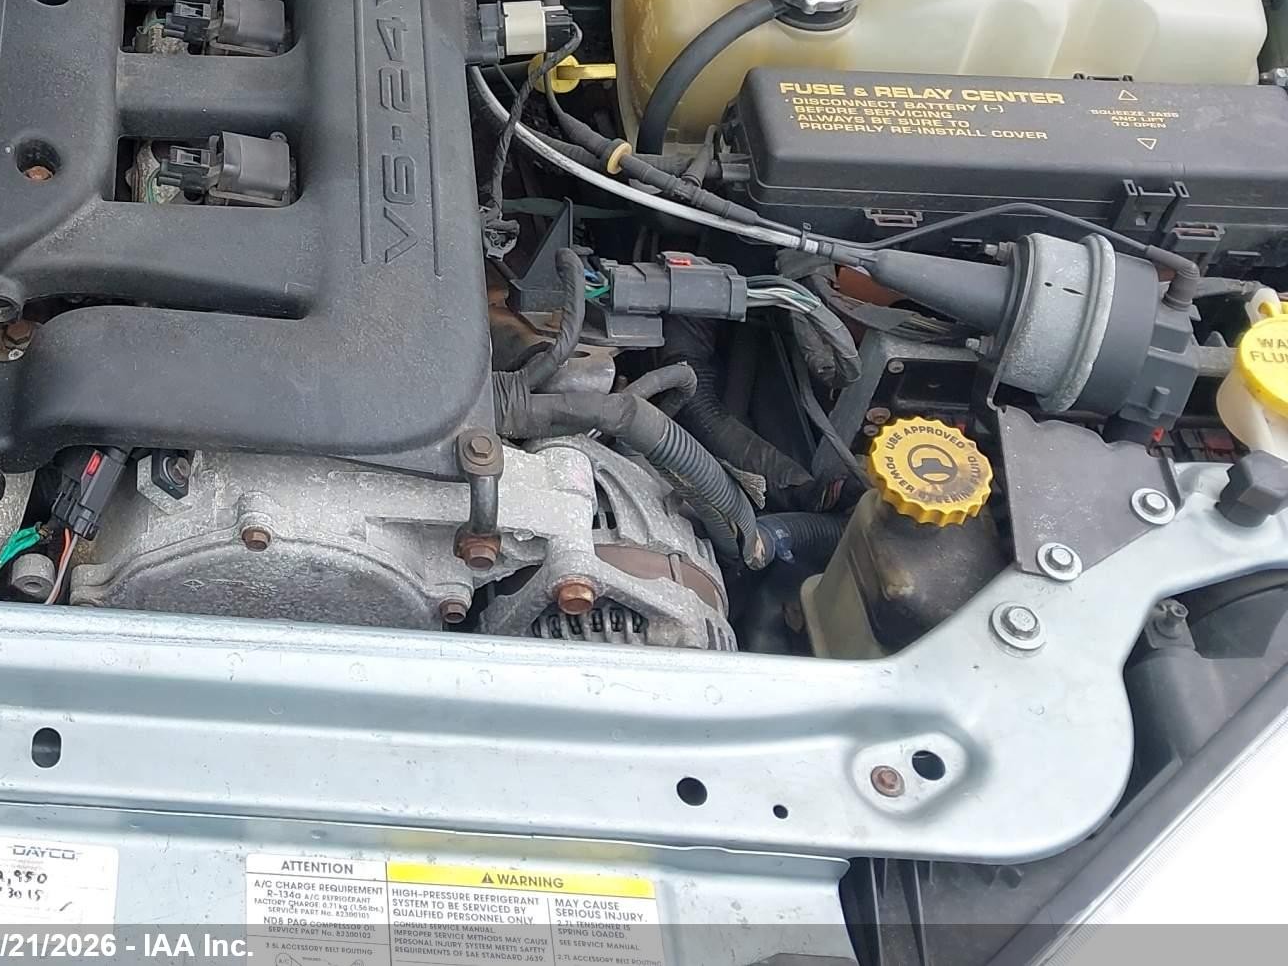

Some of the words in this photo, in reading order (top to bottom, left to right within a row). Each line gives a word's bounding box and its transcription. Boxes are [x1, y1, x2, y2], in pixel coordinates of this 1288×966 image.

[779, 82, 846, 96] FUSE
[854, 87, 869, 97] &
[874, 86, 953, 101] RELAY
[961, 89, 1064, 106] CENTER
[794, 105, 859, 115] BEFORE
[864, 108, 953, 120] SERVICING
[904, 101, 977, 112] BATTERY
[797, 113, 866, 125] ALWAYS
[872, 117, 895, 126] BE
[900, 118, 944, 127] SURE
[948, 120, 970, 129] TO
[800, 122, 884, 134] PROPERLY
[890, 125, 986, 138] RE-INSTALL
[991, 130, 1049, 141] COVER
[886, 432, 904, 450] USE
[903, 425, 966, 449] APPROVED
[884, 455, 916, 493] POWER
[11, 844, 77, 860] DAYCO
[281, 860, 354, 874] ATTENTION
[253, 879, 273, 889] A/C
[275, 880, 316, 891] CHARGE
[318, 883, 384, 896] REQUIREMENT
[496, 873, 565, 889] WARNING
[254, 897, 286, 907] FACTORY
[266, 889, 302, 900] R-134a
[304, 894, 320, 902] A/C
[322, 895, 372, 905] REFRIGERANT
[391, 888, 471, 902] HIGH-PRESSURE
[473, 894, 540, 906] REFRIGERANT
[554, 897, 579, 908] MAY
[582, 900, 621, 911] CAUSE
[268, 906, 298, 915] SERVICE
[300, 908, 319, 916] PART
[392, 898, 430, 909] SYSTEM
[431, 900, 445, 910] TO
[447, 902, 460, 911] BE
[462, 903, 512, 915] SERVICED
[513, 906, 527, 915] BY
[392, 908, 444, 920] QUALIFIED
[446, 911, 505, 924] PERSONNEL
[555, 907, 601, 920] SERIOUS
[604, 911, 648, 923] INJURY.
[268, 925, 299, 934] SERVICE
[300, 927, 319, 936] PART
[287, 917, 308, 928] PAG
[309, 920, 361, 931] COMPRESSOR
[363, 923, 377, 933] OIL
[393, 920, 428, 930] CONSULT
[429, 923, 460, 932] SERVICE
[557, 928, 589, 937] SPRING
[575, 921, 621, 931] TENSIONER
[393, 929, 433, 939] IMPROPER
[433, 931, 465, 940] SERVICE
[466, 933, 503, 943] METHODS
[504, 936, 522, 944] MAY
[523, 937, 549, 946] CAUSE
[573, 940, 604, 949] SERVICE
[281, 942, 324, 953] ACCESSORY
[342, 947, 374, 956] ROUTING
[394, 937, 433, 947] PERSONAL
[464, 942, 494, 951] SYSTEM
[495, 944, 518, 953] MEETS
[519, 946, 547, 955] SAFETY
[394, 946, 452, 957] REQUIREMENTS
[481, 952, 523, 962] STANDARD
[573, 955, 614, 964] ACCESSORY
